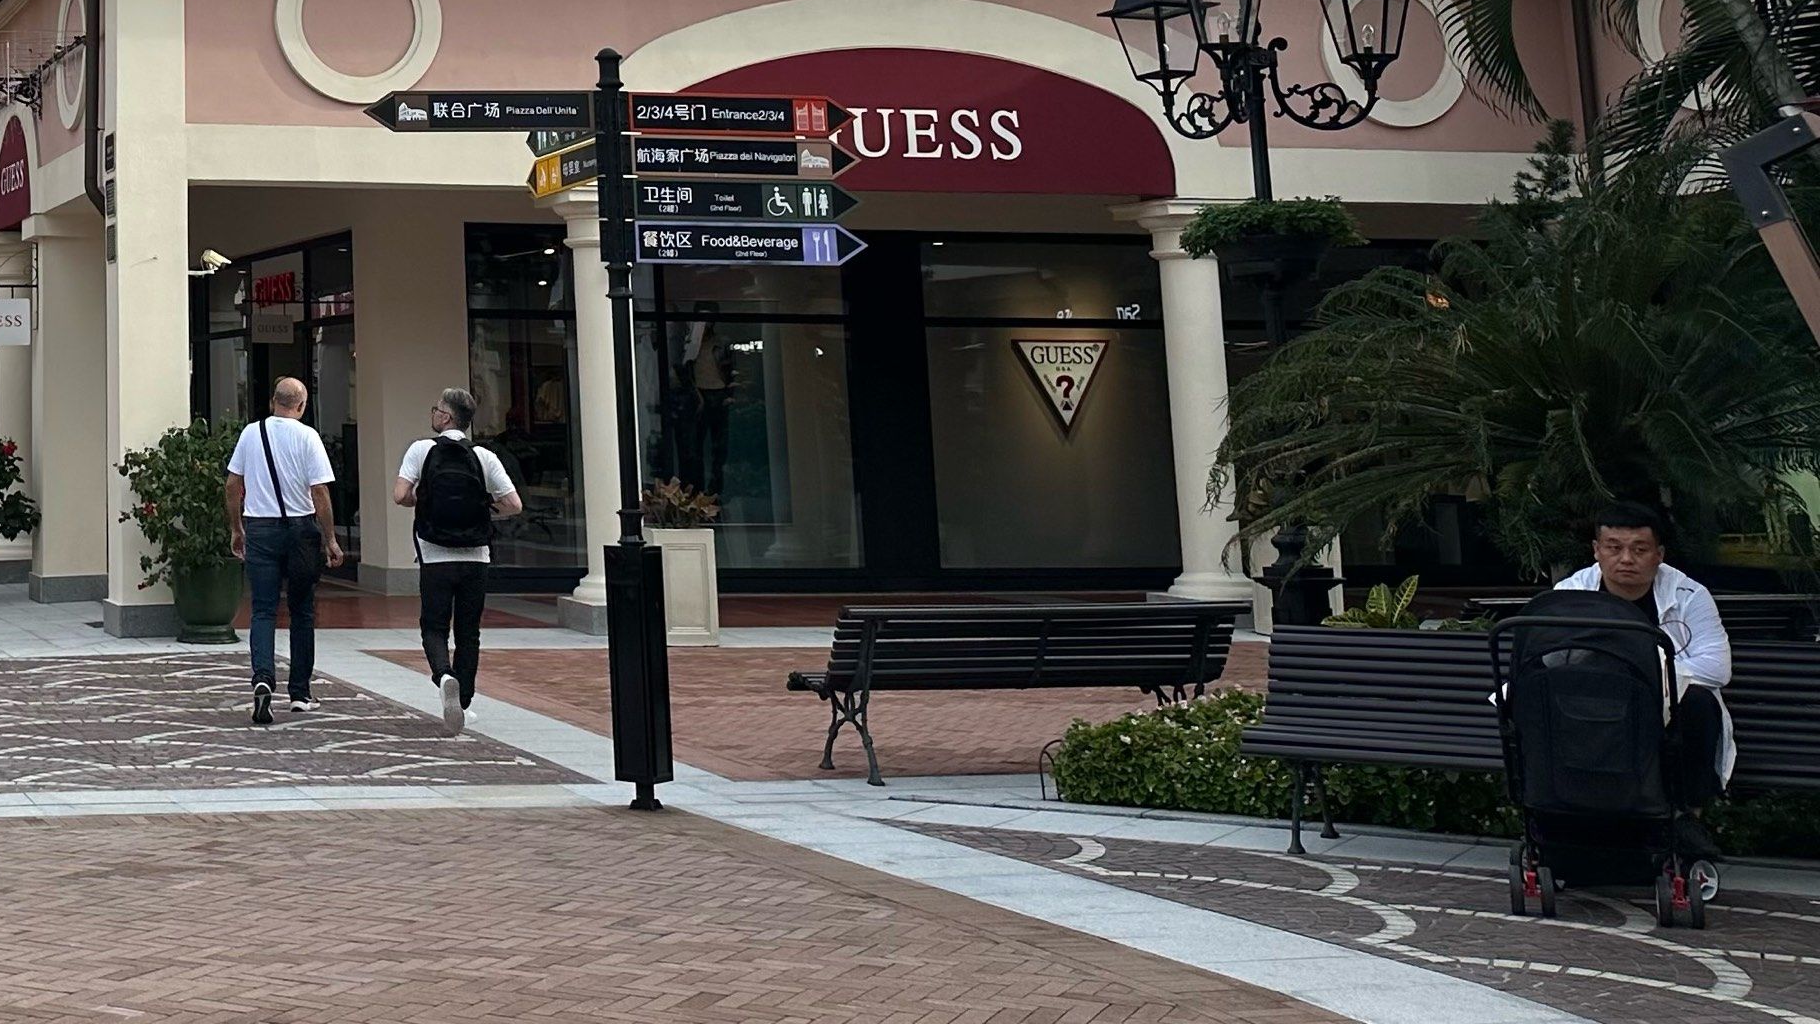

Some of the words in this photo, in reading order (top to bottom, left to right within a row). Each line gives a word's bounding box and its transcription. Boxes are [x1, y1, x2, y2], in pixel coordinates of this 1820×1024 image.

[433, 102, 500, 119] 联合广场
[505, 106, 535, 115] Piazza
[636, 104, 707, 121] 2/3/4号门
[829, 106, 1023, 161] UESS
[636, 147, 710, 164] 航海家广场
[710, 151, 739, 161] Piazza
[754, 152, 797, 164] Navigatori
[0, 159, 25, 196] GUESS
[643, 186, 693, 204] 卫生间
[714, 193, 735, 202] Toilet
[643, 230, 693, 249] 餐饮区
[701, 234, 799, 250] Food&Beverage
[1030, 346, 1094, 364] GUESS
